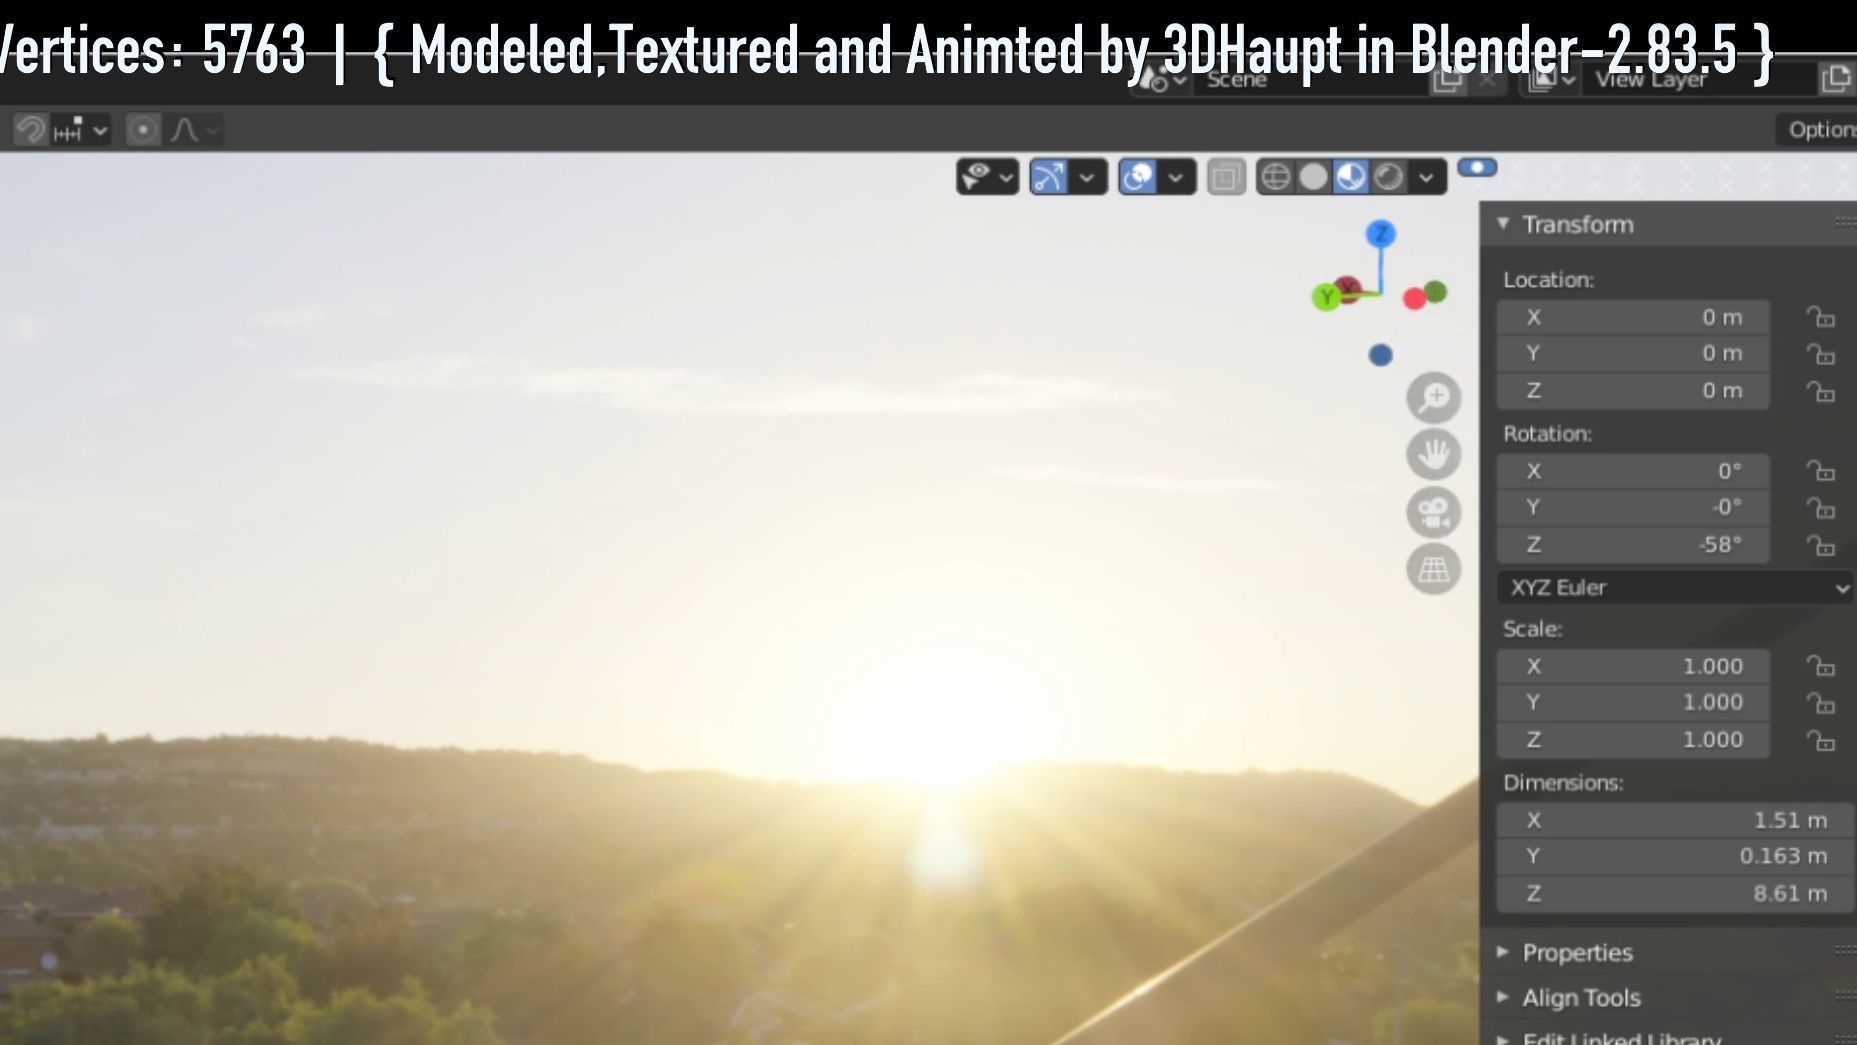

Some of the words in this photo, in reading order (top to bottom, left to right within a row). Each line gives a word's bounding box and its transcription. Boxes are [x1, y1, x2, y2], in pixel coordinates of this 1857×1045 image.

[1207, 71, 1268, 88] Scene
[1596, 71, 1644, 88] View
[1652, 72, 1708, 92] Layer
[1523, 215, 1633, 233] Transform
[1505, 272, 1593, 288] Location:
[1528, 309, 1540, 325] X
[1704, 309, 1715, 325] 0
[1724, 313, 1742, 325] m
[1527, 345, 1539, 361] Y
[1704, 345, 1715, 361] 0
[1724, 349, 1742, 361] m
[1528, 382, 1541, 398] Z
[1704, 382, 1715, 398] 0
[1724, 386, 1742, 398] m
[1505, 425, 1590, 441] Rotation:
[1528, 464, 1541, 479] X
[1527, 499, 1539, 515] Y
[1527, 536, 1541, 552] Z
[1513, 579, 1550, 595] XYZ
[1558, 579, 1606, 595] Euler
[1504, 620, 1561, 637] Scale:
[1528, 658, 1540, 674] X
[1685, 658, 1742, 674] 1.000
[1527, 695, 1539, 710] Y
[1686, 694, 1742, 710] 1.000
[1528, 731, 1541, 747] Z
[1685, 731, 1742, 747] 1.000
[1505, 774, 1622, 791] Dimensions:
[1528, 812, 1540, 828] X
[1756, 812, 1799, 828] 1.51
[1809, 816, 1827, 828] m
[1527, 848, 1539, 864] Y
[1741, 848, 1800, 864] 0.163
[1809, 851, 1827, 864] m
[1528, 885, 1541, 901] Z
[1755, 885, 1799, 901] 8.61
[1809, 889, 1827, 901] m
[1525, 944, 1633, 965] Properties
[1523, 989, 1578, 1011] Align
[1584, 989, 1641, 1006] Tools
